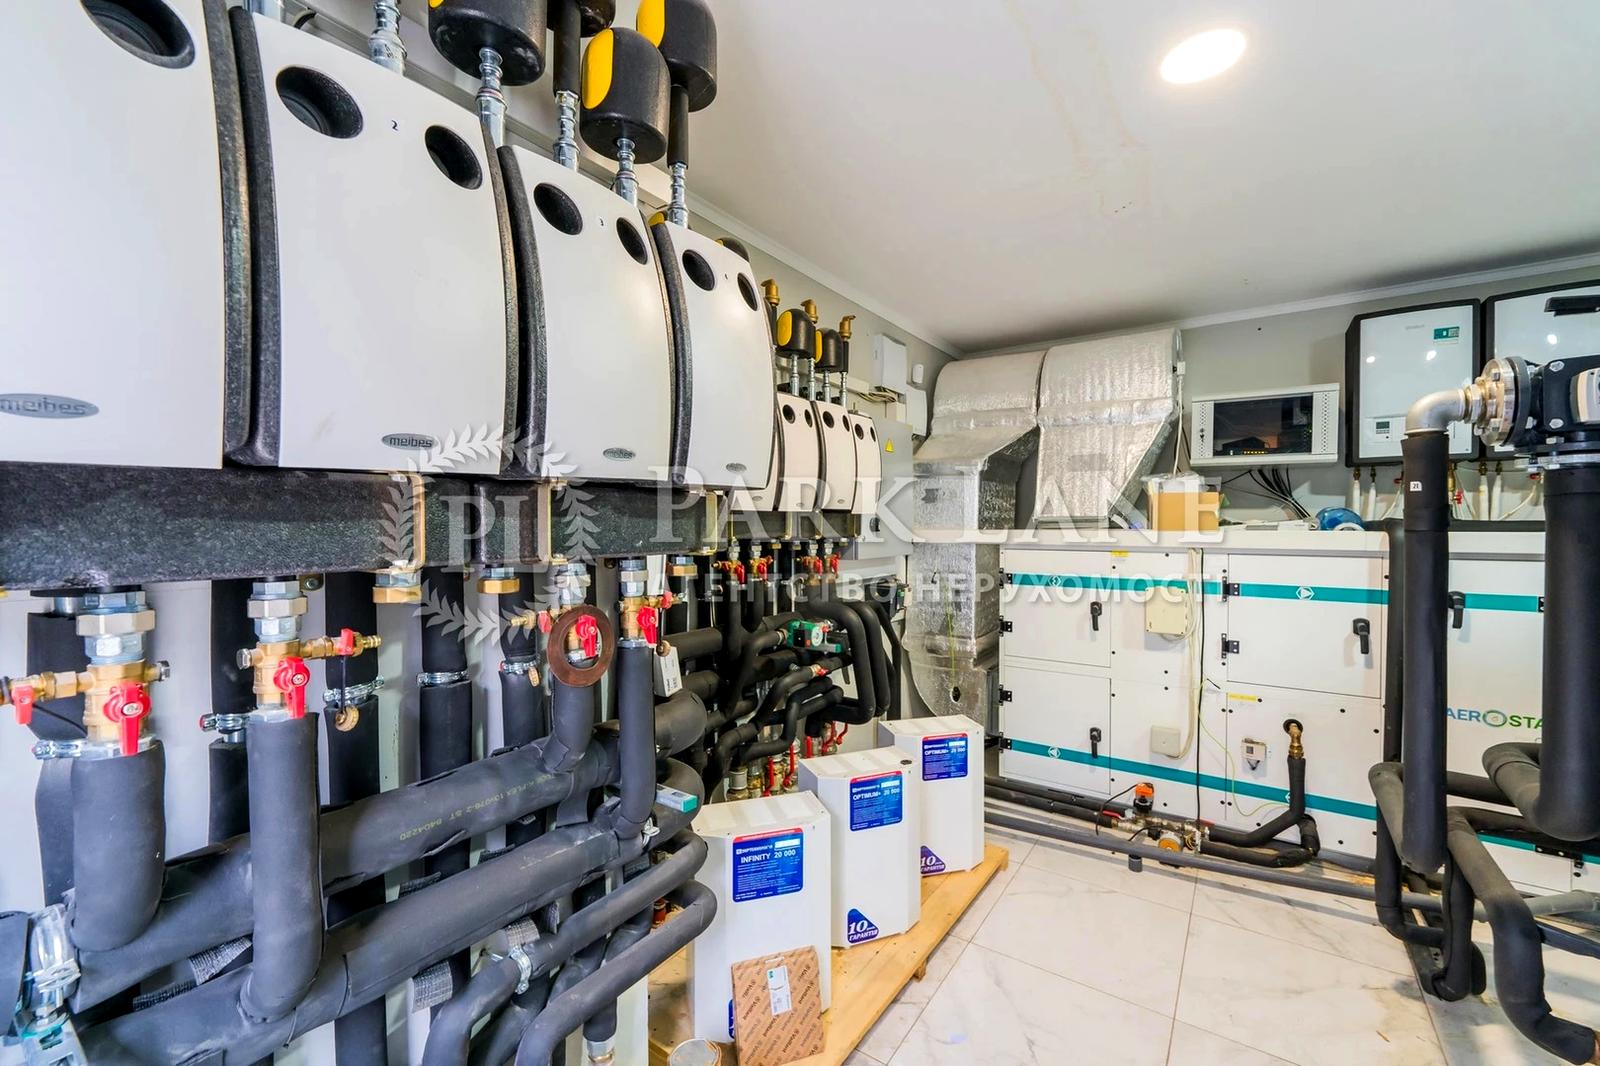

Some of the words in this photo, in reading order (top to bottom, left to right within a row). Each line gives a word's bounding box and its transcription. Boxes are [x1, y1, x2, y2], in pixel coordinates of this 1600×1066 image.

[391, 119, 398, 131] 2
[0, 396, 86, 416] meibes
[389, 436, 433, 448] meibes
[740, 852, 771, 864] INFINITY
[774, 850, 783, 859] 20
[784, 849, 797, 857] 000
[848, 920, 868, 935] 10
